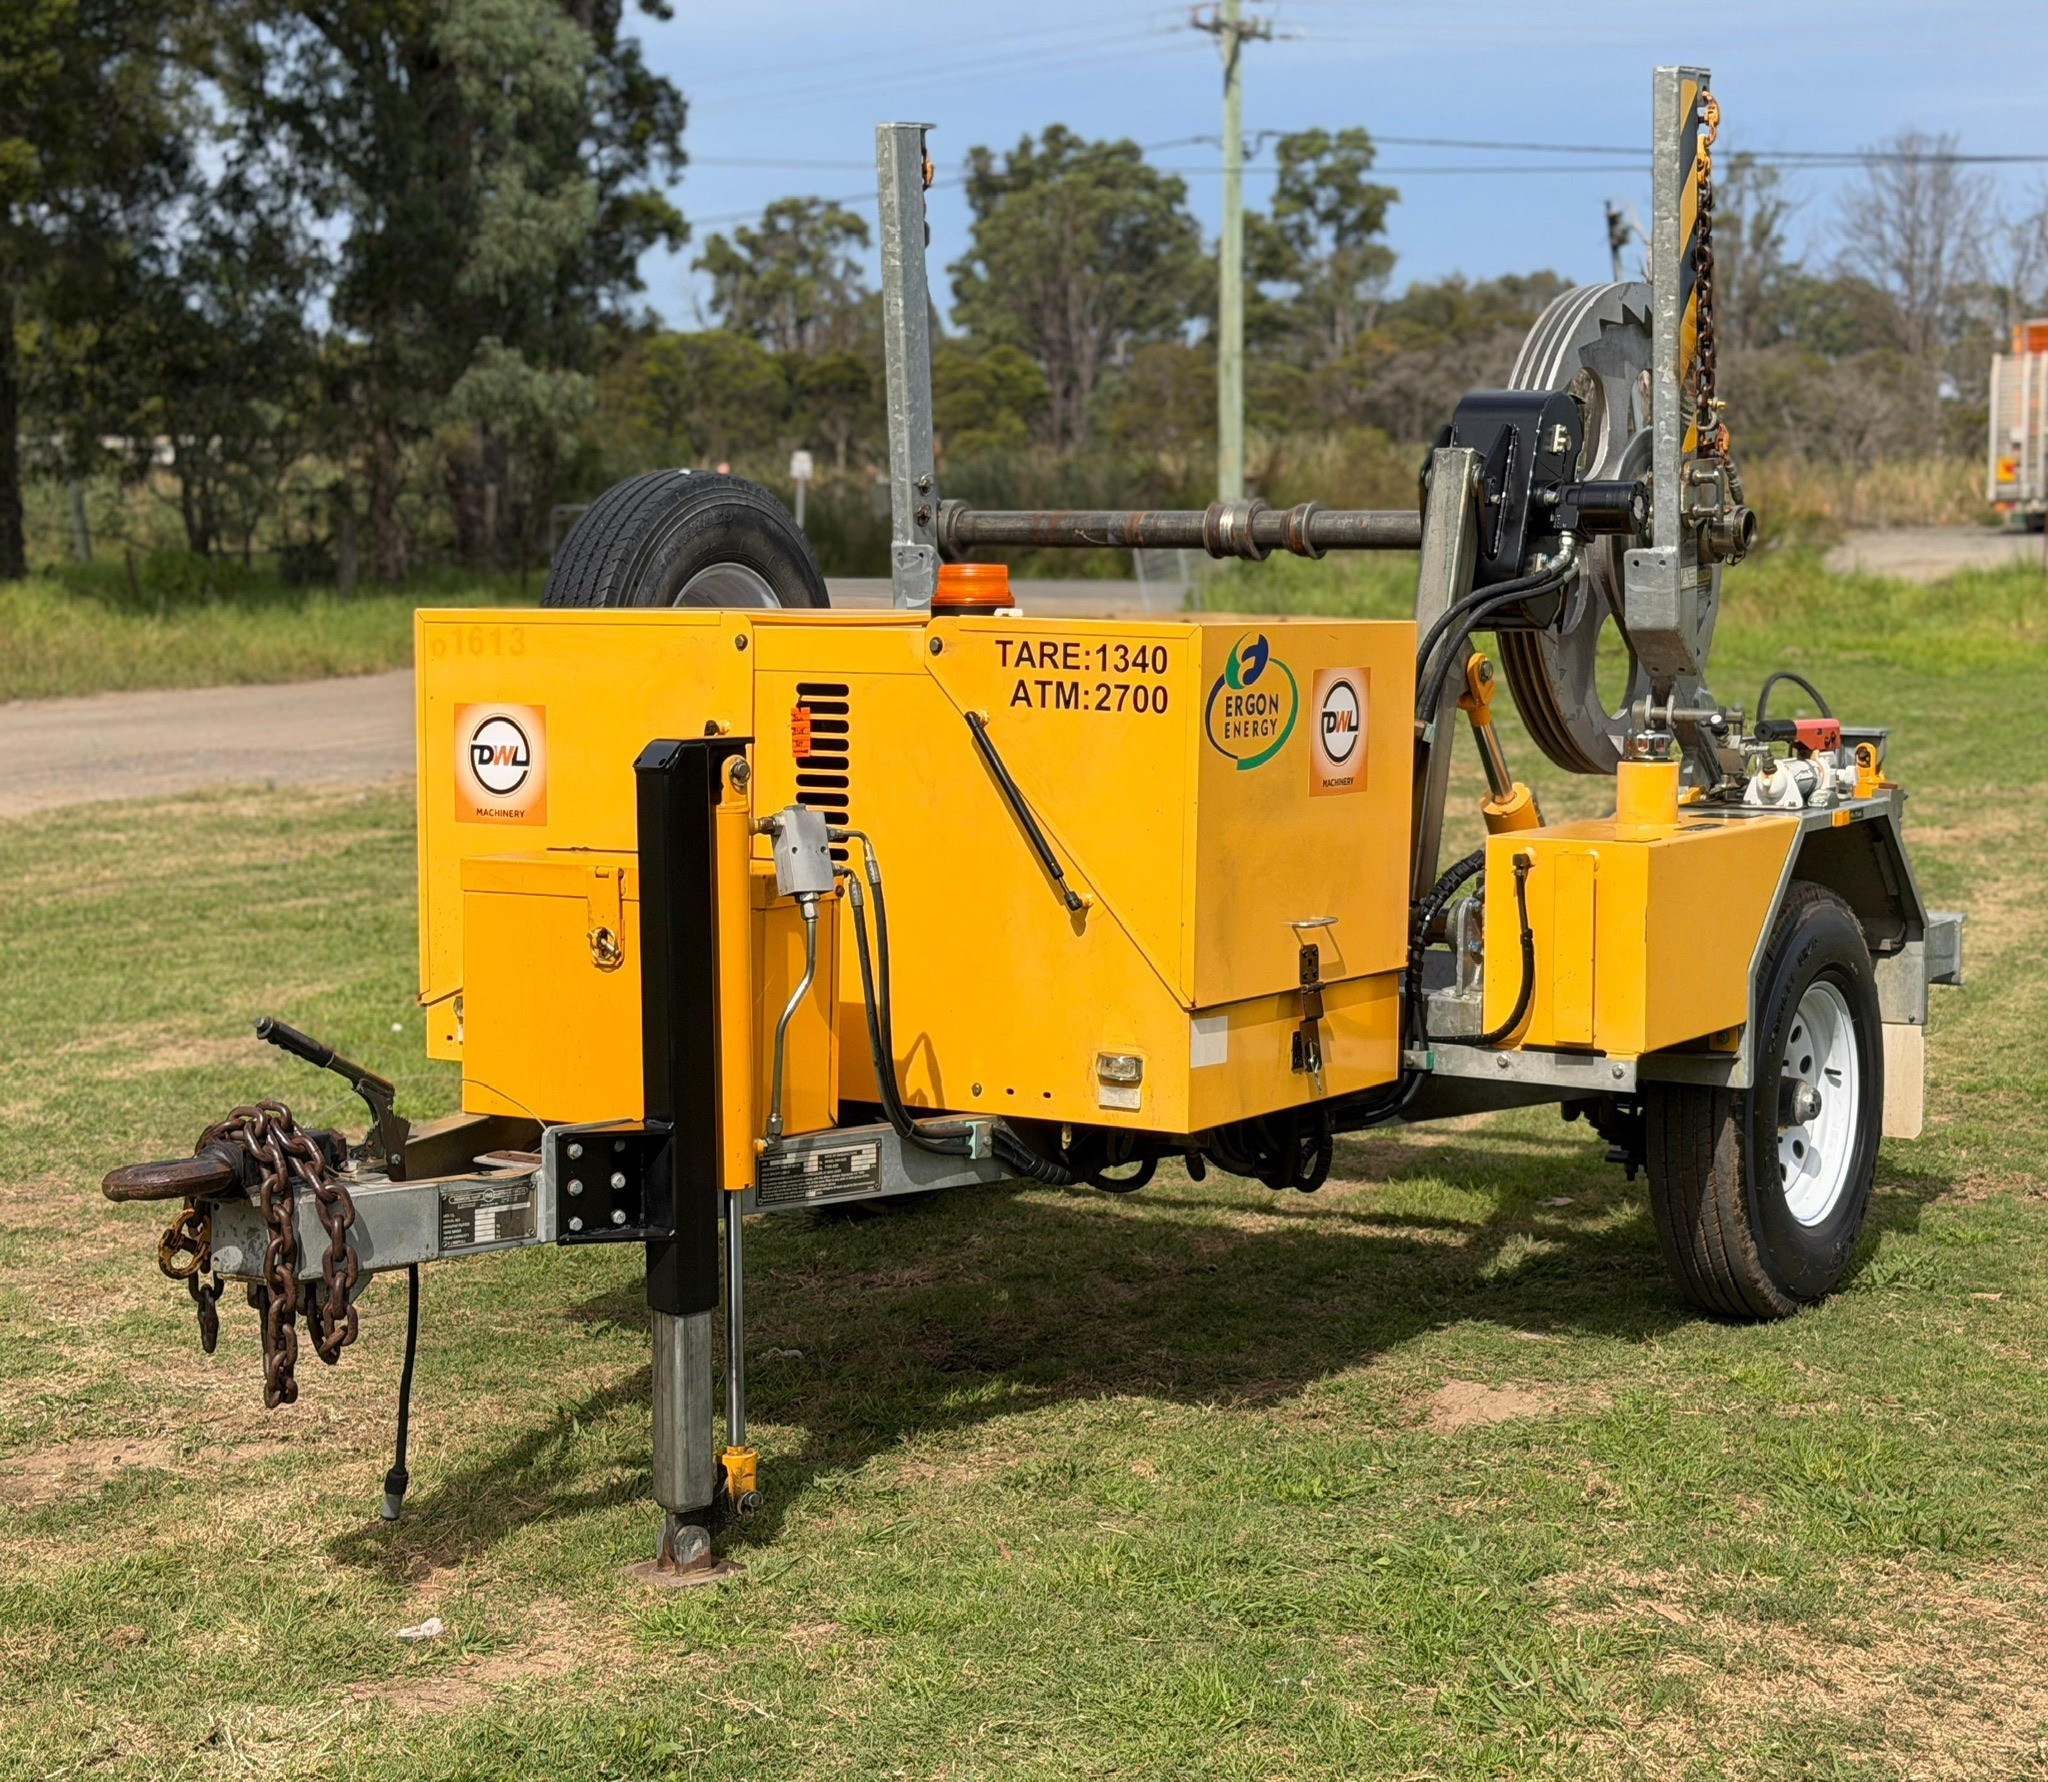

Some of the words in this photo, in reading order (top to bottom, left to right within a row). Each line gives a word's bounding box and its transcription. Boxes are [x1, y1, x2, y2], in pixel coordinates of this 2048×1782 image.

[995, 639, 1168, 675] TARE:1340
[1009, 679, 1168, 714] ATM:2700
[1225, 693, 1279, 717] ERGON
[1224, 718, 1278, 739] ENERGY
[1322, 710, 1359, 734] DWL
[470, 744, 530, 767] DWL
[1322, 777, 1354, 787] MACHINERY
[476, 808, 526, 818] MACHINERY
